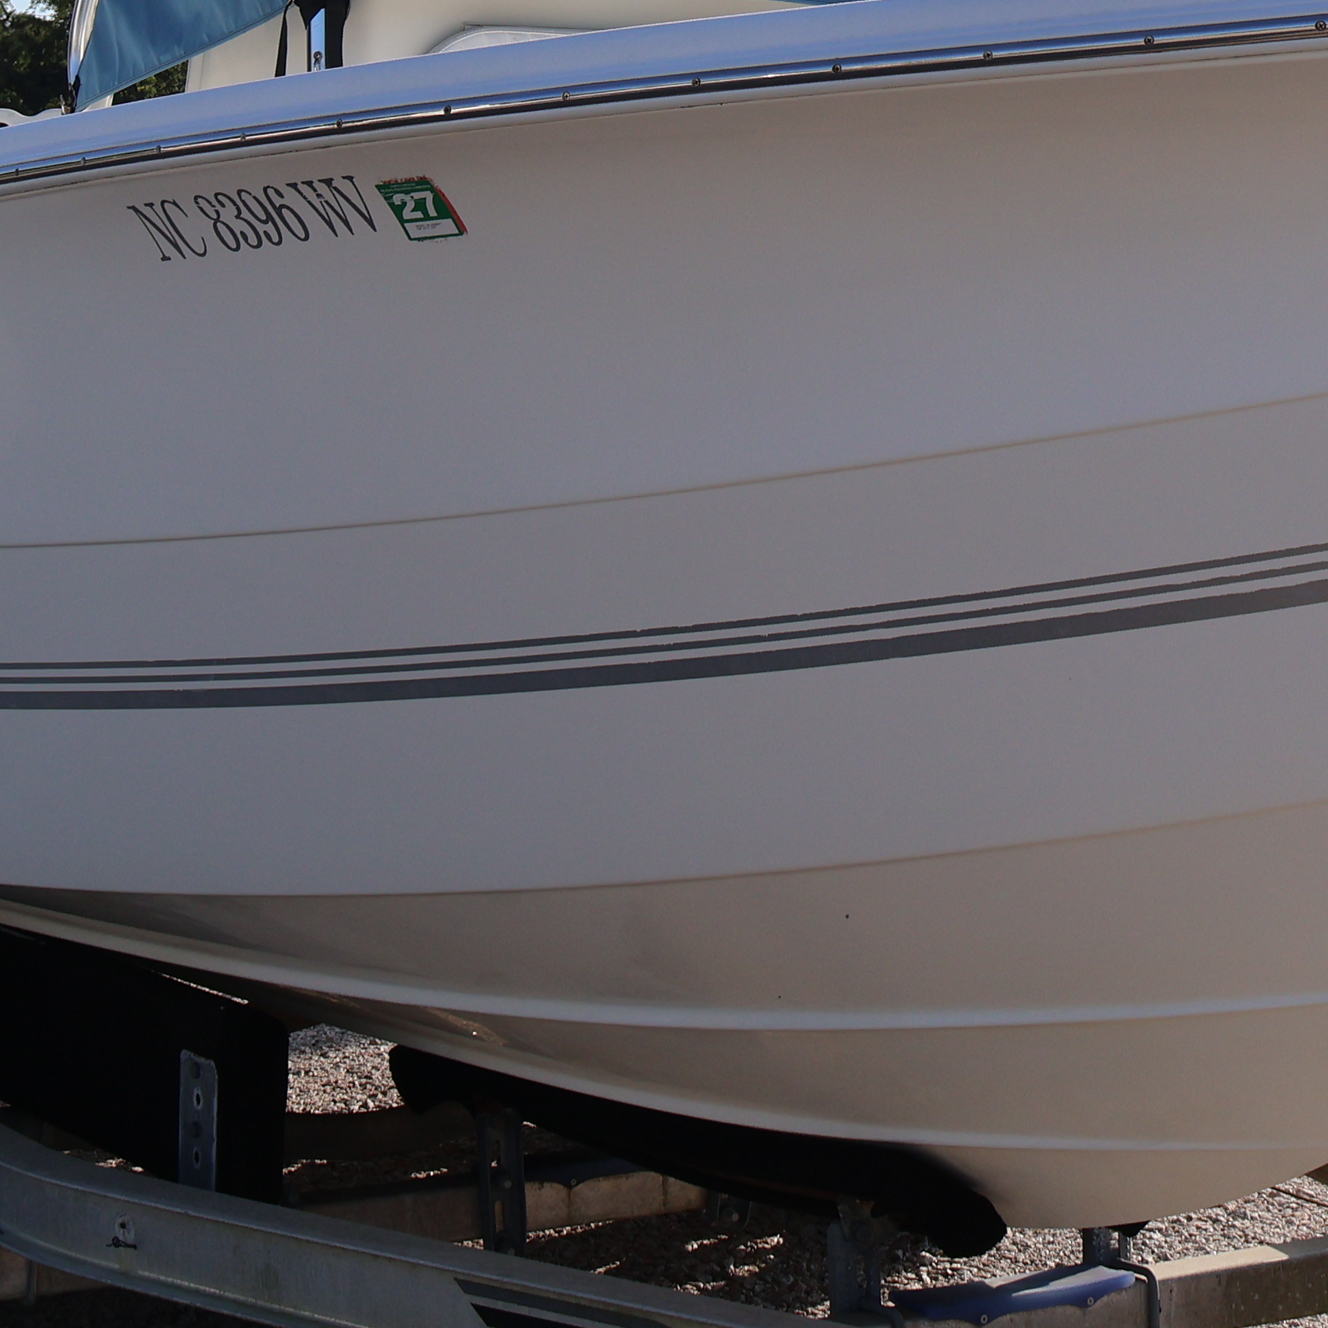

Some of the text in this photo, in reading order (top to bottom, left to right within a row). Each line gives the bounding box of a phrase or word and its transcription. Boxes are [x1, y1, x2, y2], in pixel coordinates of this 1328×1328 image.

[126, 199, 207, 262] NC
[193, 185, 310, 252] 8396
[392, 190, 438, 220] 27
